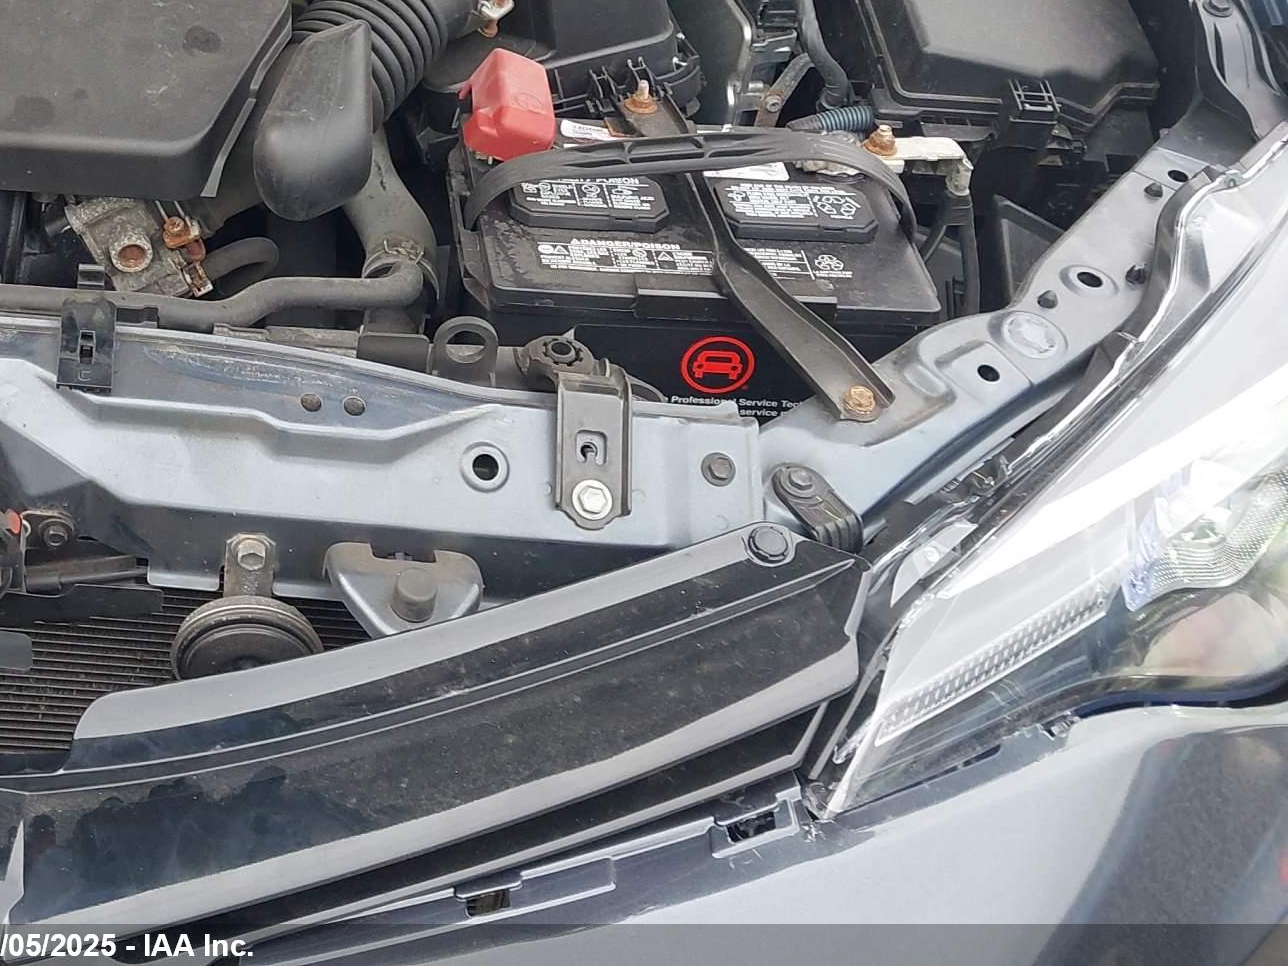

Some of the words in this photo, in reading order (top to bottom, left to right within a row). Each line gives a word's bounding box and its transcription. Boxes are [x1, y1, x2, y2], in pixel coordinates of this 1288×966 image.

[580, 239, 681, 251] DANGER/POISON
[739, 398, 778, 407] Service
[780, 400, 803, 408] Tec
[739, 408, 778, 417] service
